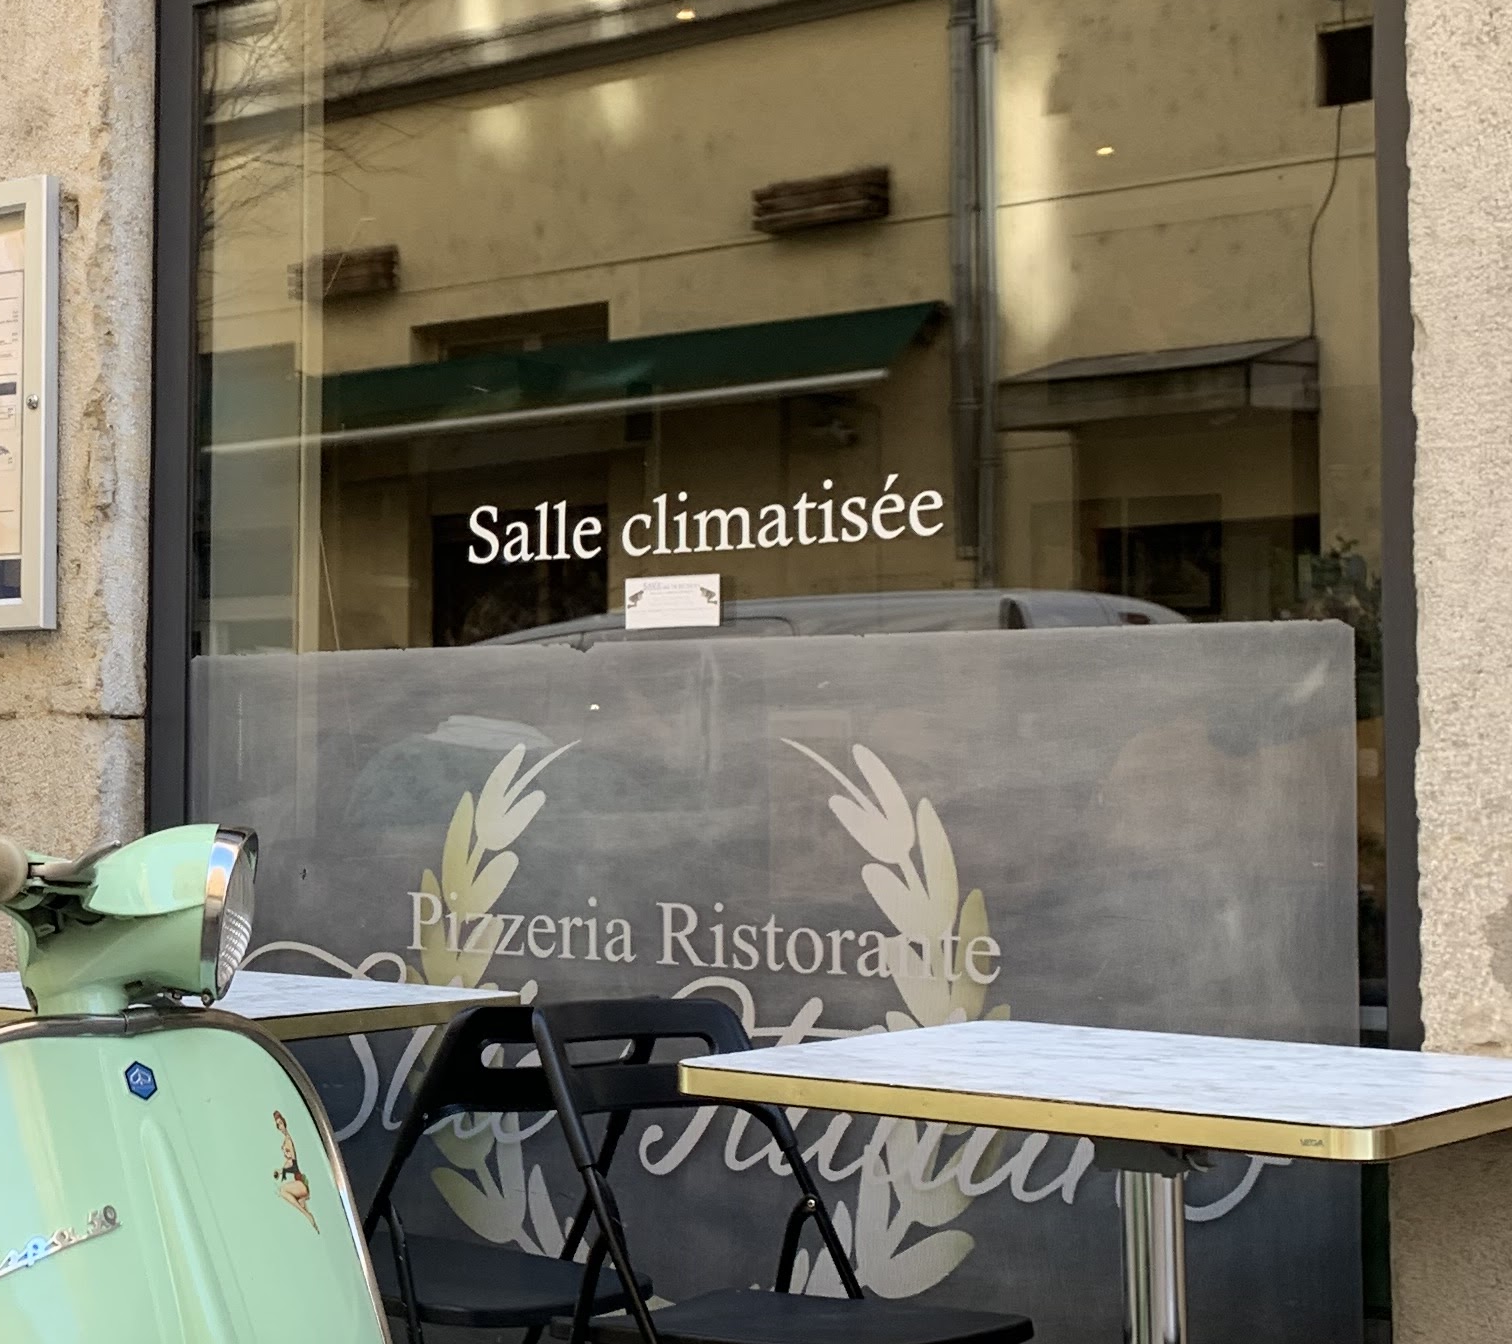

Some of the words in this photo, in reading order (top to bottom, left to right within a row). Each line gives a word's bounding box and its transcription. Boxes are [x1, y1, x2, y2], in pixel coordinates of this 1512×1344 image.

[467, 499, 602, 565] Salle
[621, 473, 945, 557] climatisée
[406, 890, 636, 964] Pizzeria
[656, 902, 1002, 985] Ristorante
